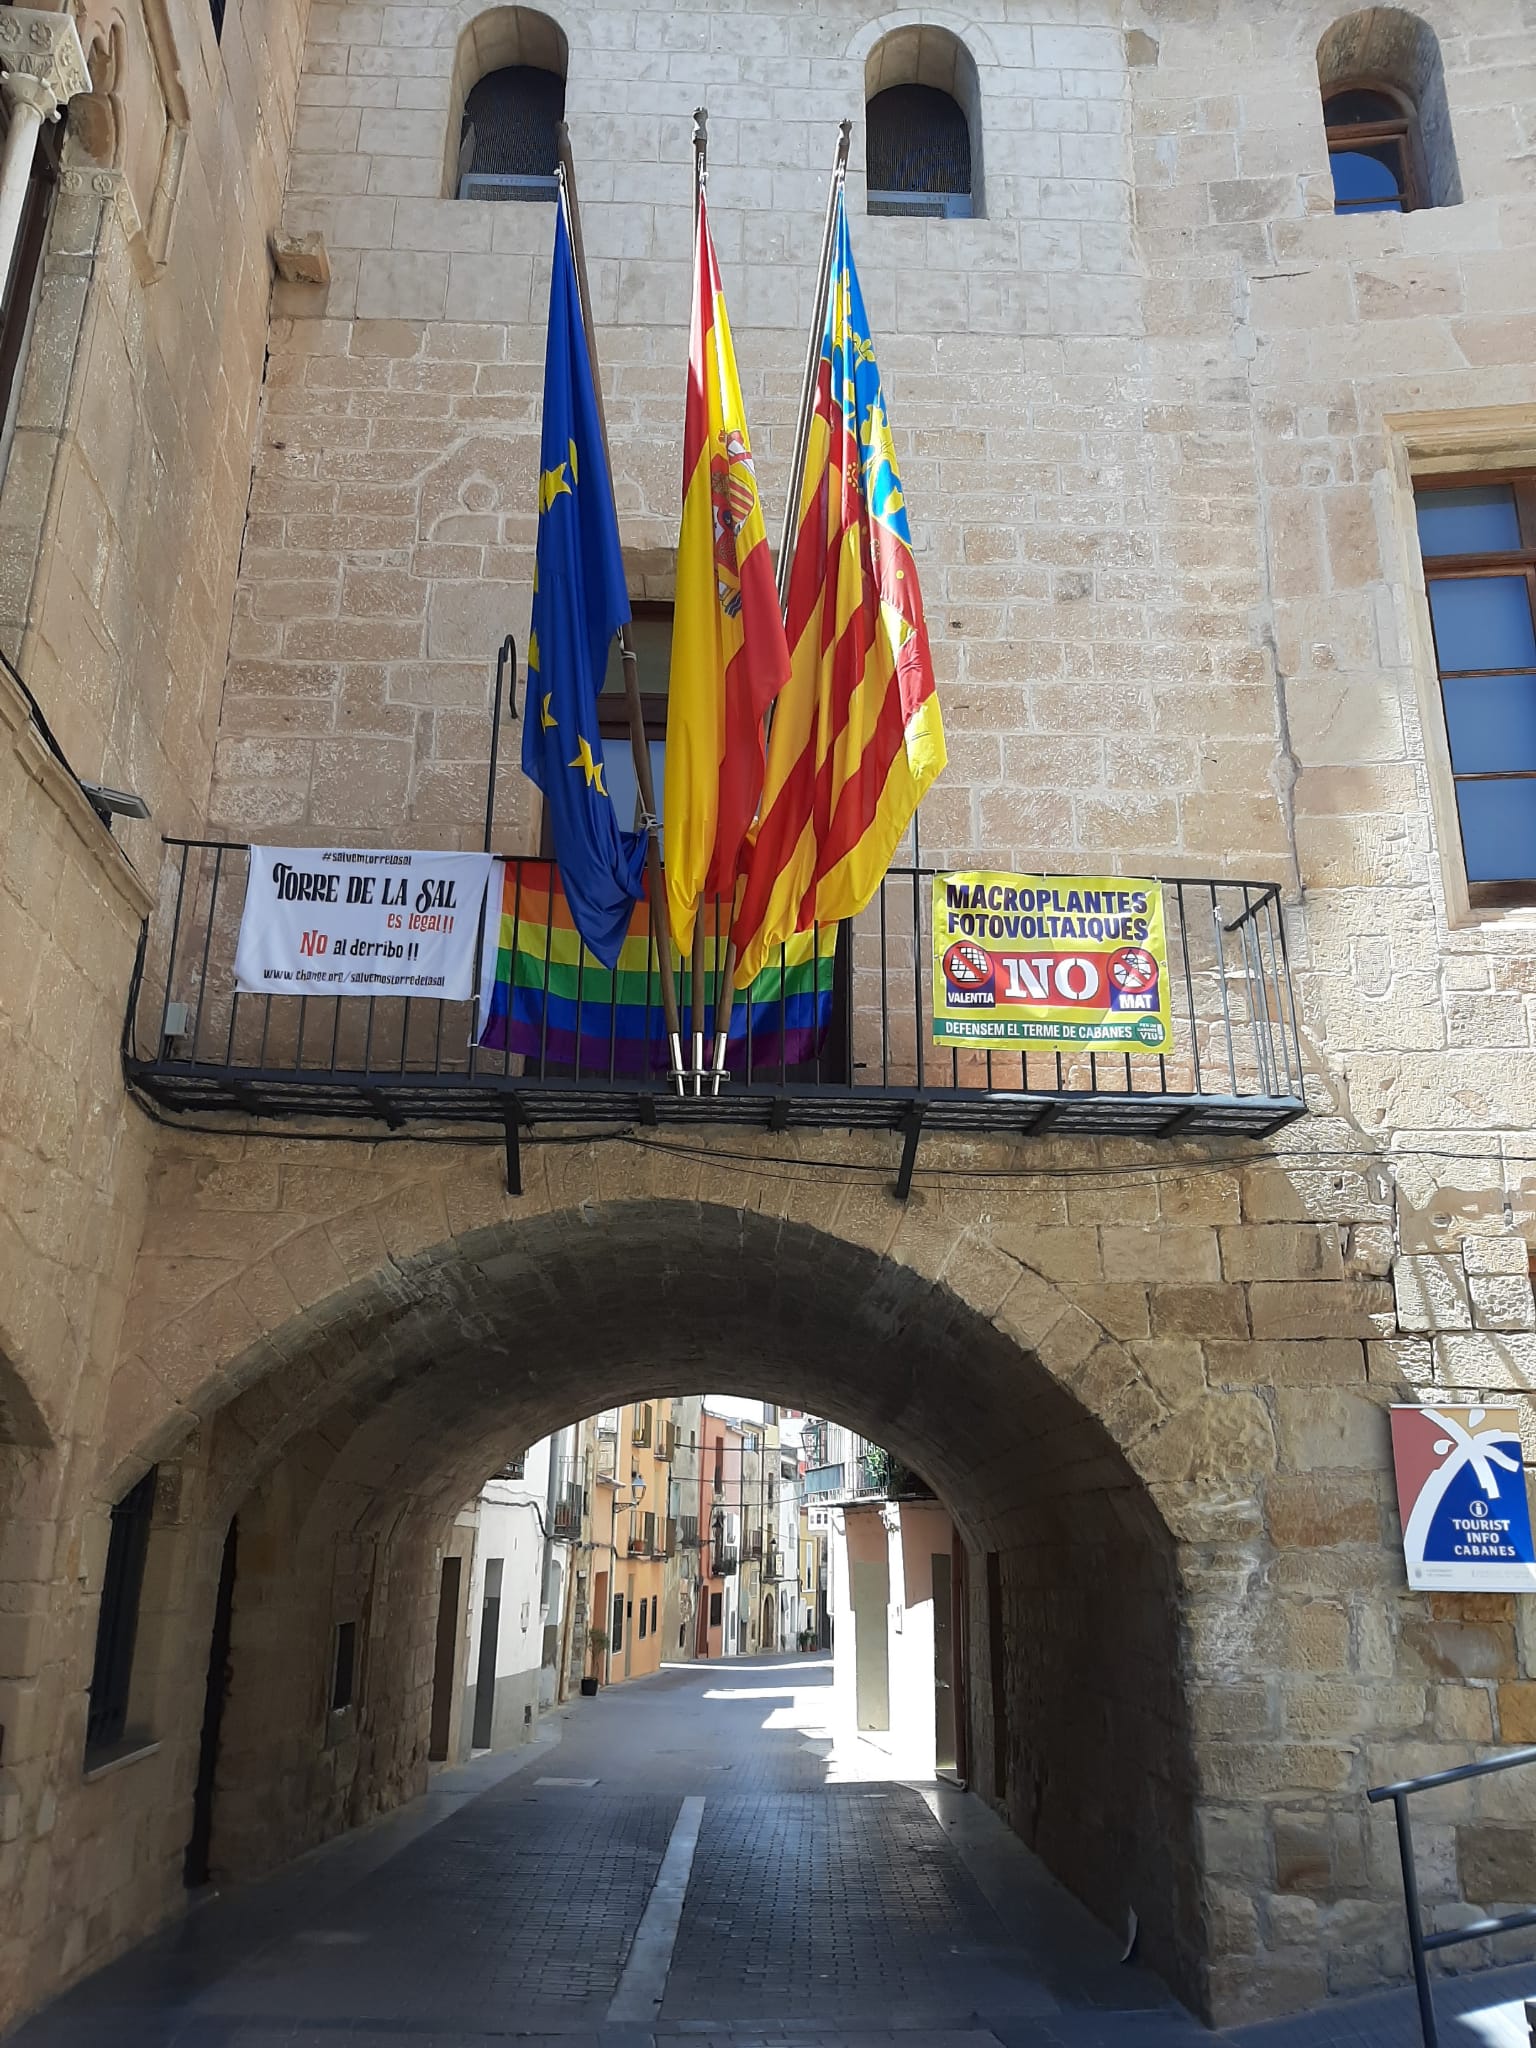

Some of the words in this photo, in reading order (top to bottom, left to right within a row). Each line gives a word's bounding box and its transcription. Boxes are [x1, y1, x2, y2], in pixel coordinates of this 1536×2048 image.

[272, 862, 340, 904] TORRE
[346, 876, 376, 905] DE
[381, 878, 408, 906] LA
[415, 879, 456, 913] SAL
[946, 884, 1148, 914] MACROPLANTES
[387, 913, 402, 929] es
[408, 913, 454, 934] legal!!
[948, 912, 1149, 942] FOTOVOLTAIQUES
[333, 939, 346, 956] al
[350, 939, 403, 959] derribo
[1002, 957, 1099, 1000] NO
[948, 992, 994, 1004] VALENTIA
[1119, 994, 1153, 1009] MAT
[945, 1021, 1003, 1036] DEFENSEM
[1007, 1023, 1019, 1036] EL
[1022, 1024, 1060, 1037] TERME
[1063, 1025, 1075, 1037] DE
[1078, 1025, 1132, 1039] CABANES
[1452, 1519, 1510, 1531] TOURIST
[1467, 1532, 1499, 1543] INFO
[1455, 1545, 1515, 1556] CABANES
